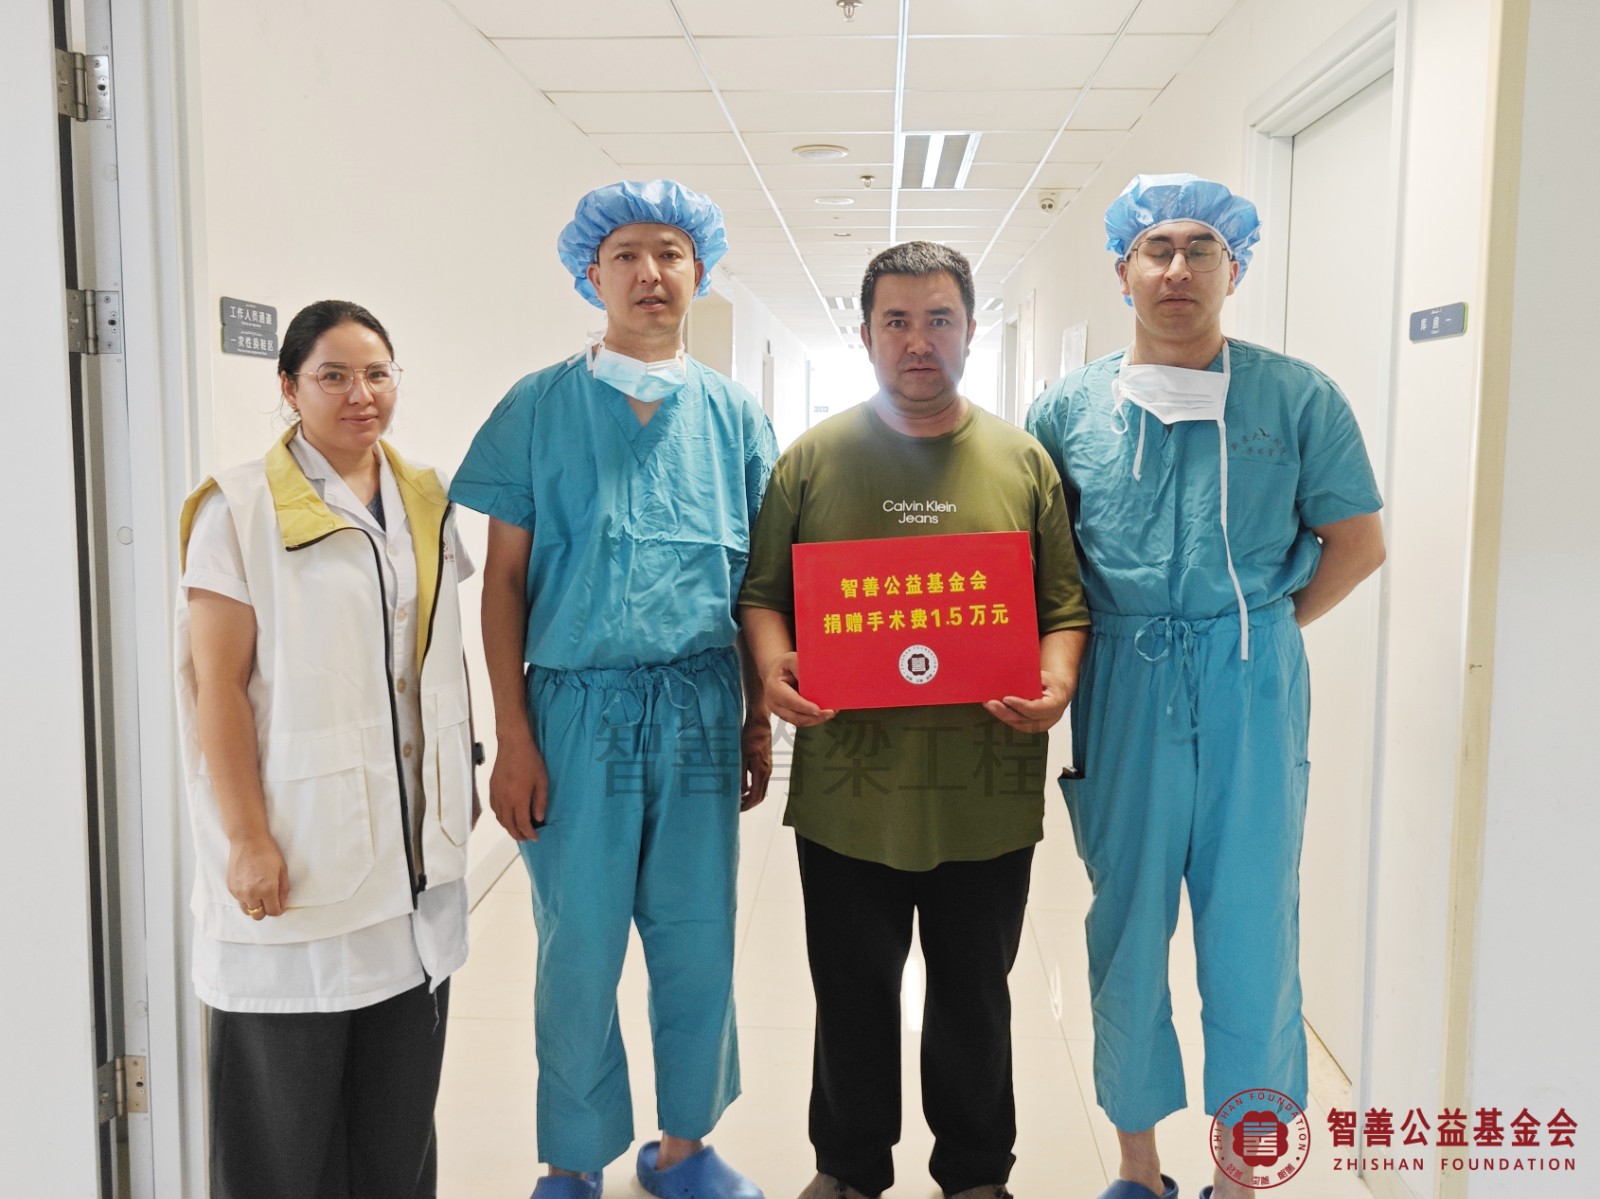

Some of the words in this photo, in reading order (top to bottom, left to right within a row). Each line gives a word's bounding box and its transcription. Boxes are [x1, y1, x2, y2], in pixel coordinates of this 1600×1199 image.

[882, 499, 924, 512] Calvin
[926, 500, 957, 513] Klein
[898, 511, 939, 524] Jeans
[840, 570, 988, 599] 智善公益基金会
[823, 603, 1010, 635] 捐赠手术费1.5万元
